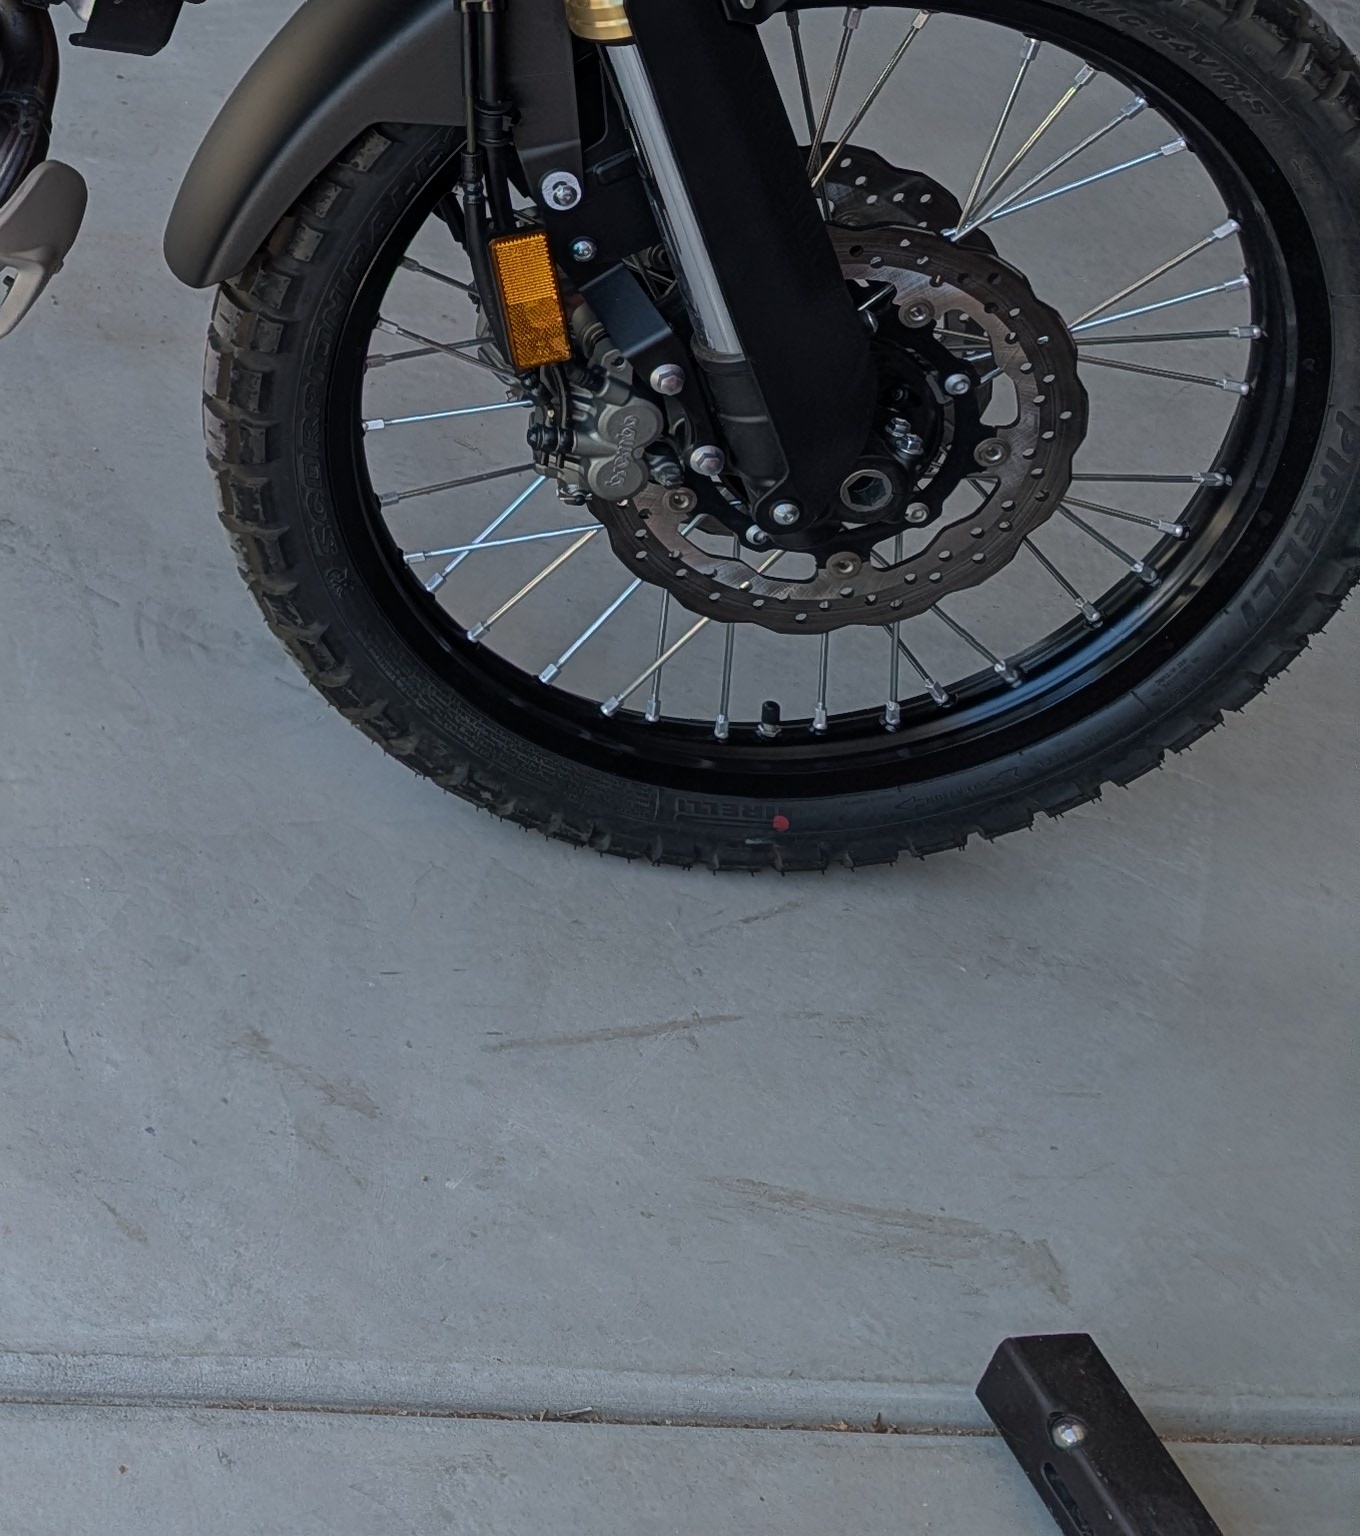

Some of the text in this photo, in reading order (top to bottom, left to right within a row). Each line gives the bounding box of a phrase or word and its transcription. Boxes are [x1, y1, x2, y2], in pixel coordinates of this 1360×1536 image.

[298, 286, 348, 558] SCORPION
[602, 414, 640, 490] brembo
[1240, 409, 1360, 628] PIRELLI
